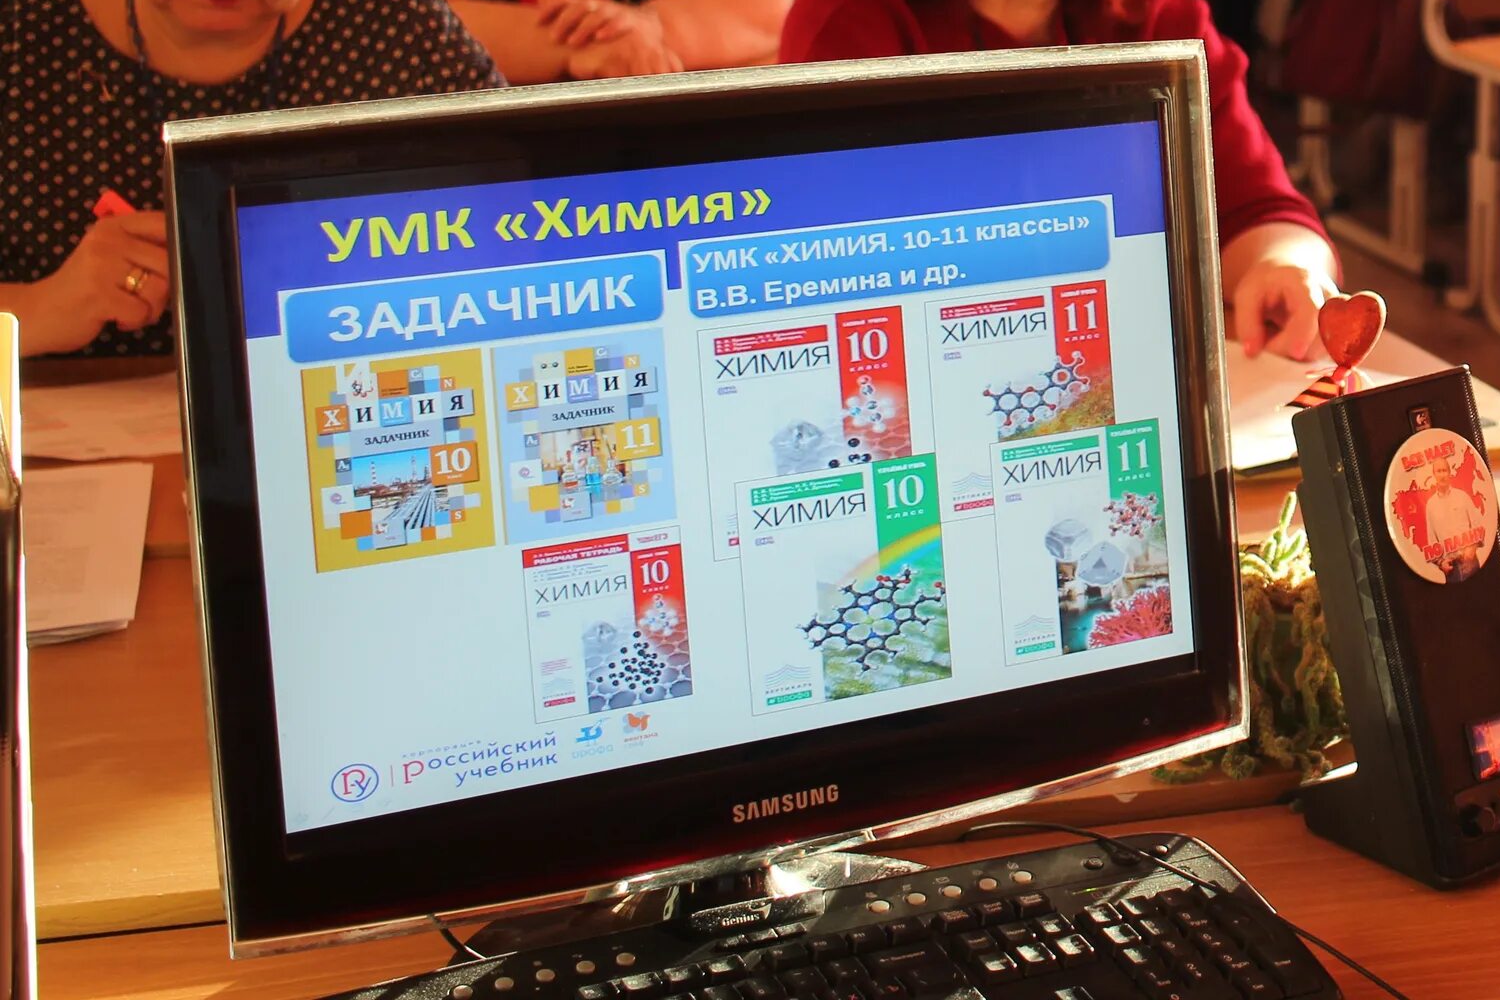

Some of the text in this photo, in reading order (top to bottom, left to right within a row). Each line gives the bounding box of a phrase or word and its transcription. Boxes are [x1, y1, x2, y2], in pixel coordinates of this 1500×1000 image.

[321, 187, 772, 263] УМК «Химия»
[692, 215, 1090, 273] УМК «ХИМИЯ. 10-11 классы»
[697, 263, 967, 310] В.В. Еремина и др.
[328, 274, 636, 342] ЗАДАЧНИК
[1064, 299, 1098, 332] 11
[941, 311, 1047, 344] ХИМИЯ
[715, 345, 831, 379] ХИМИЯ
[846, 328, 889, 363] 10
[551, 405, 615, 422] ЗАДАЧНИК
[364, 429, 430, 446] ЗАДАЧНИК
[621, 423, 655, 449] 11
[434, 448, 472, 475] 10
[1003, 451, 1102, 486] ХИМИЯ
[1117, 438, 1149, 472] 11
[882, 474, 925, 510] 10
[753, 493, 866, 530] ХИМИЯ
[1423, 544, 1445, 563] ПО
[535, 575, 628, 604] ХИМИЯ
[640, 559, 670, 586] 10
[403, 731, 558, 784] Российский
[455, 752, 558, 788] учебник
[732, 784, 839, 823] SAMSUNG
[721, 912, 760, 927] Genius
